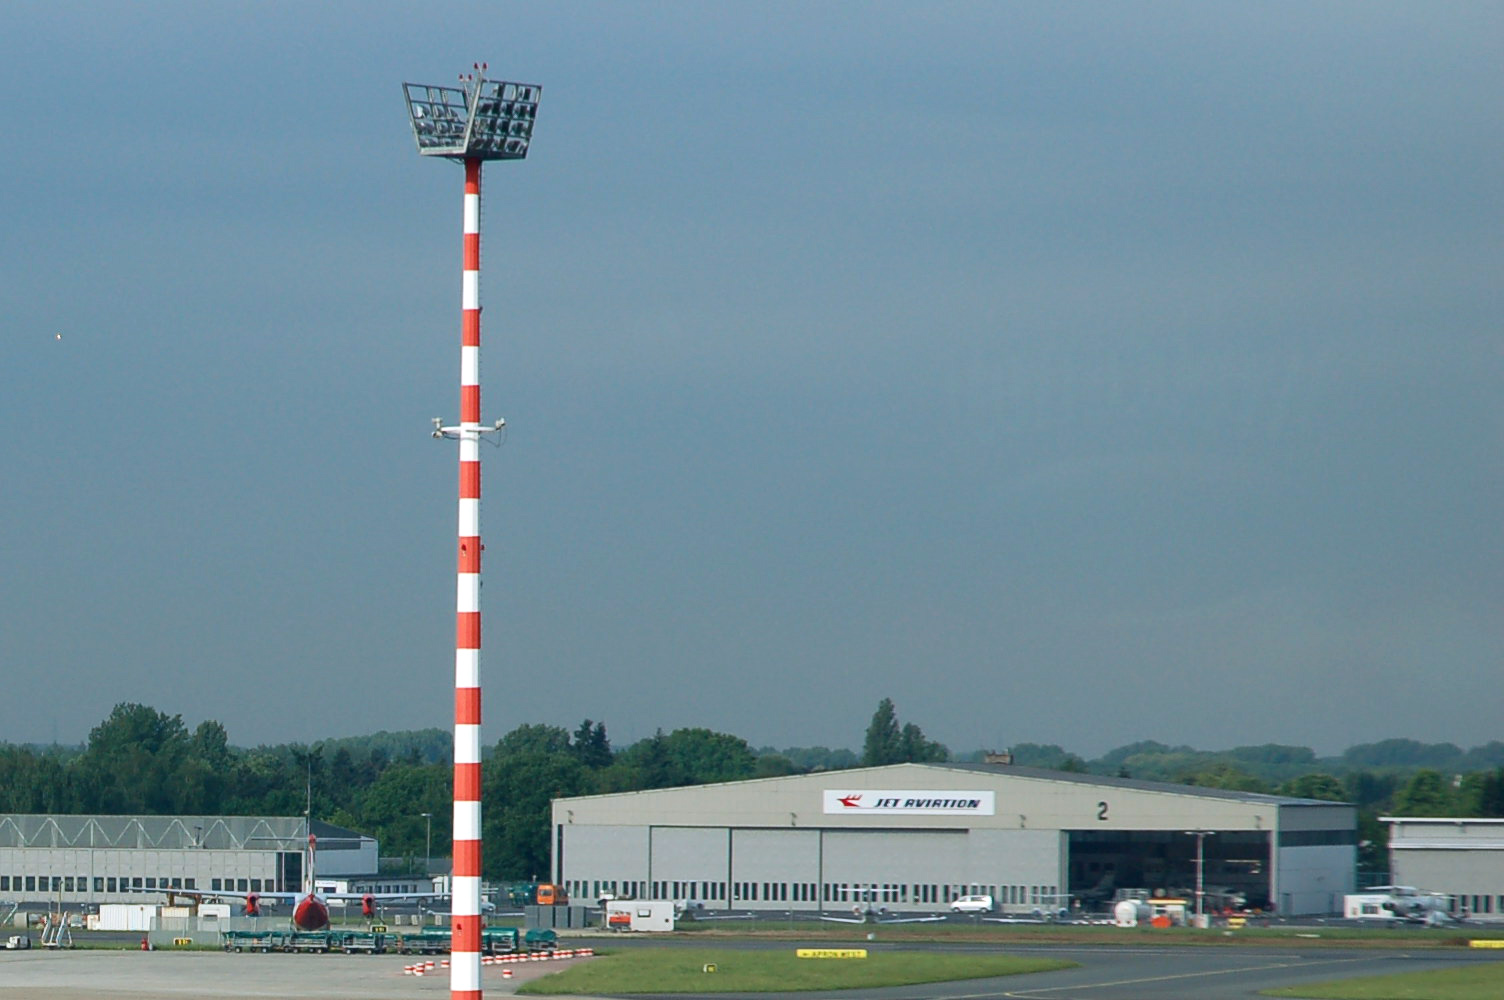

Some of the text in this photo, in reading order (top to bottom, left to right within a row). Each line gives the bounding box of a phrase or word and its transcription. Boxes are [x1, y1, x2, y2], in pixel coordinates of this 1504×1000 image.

[874, 798, 981, 809] JET AVIATION
[1098, 801, 1108, 821] 2
